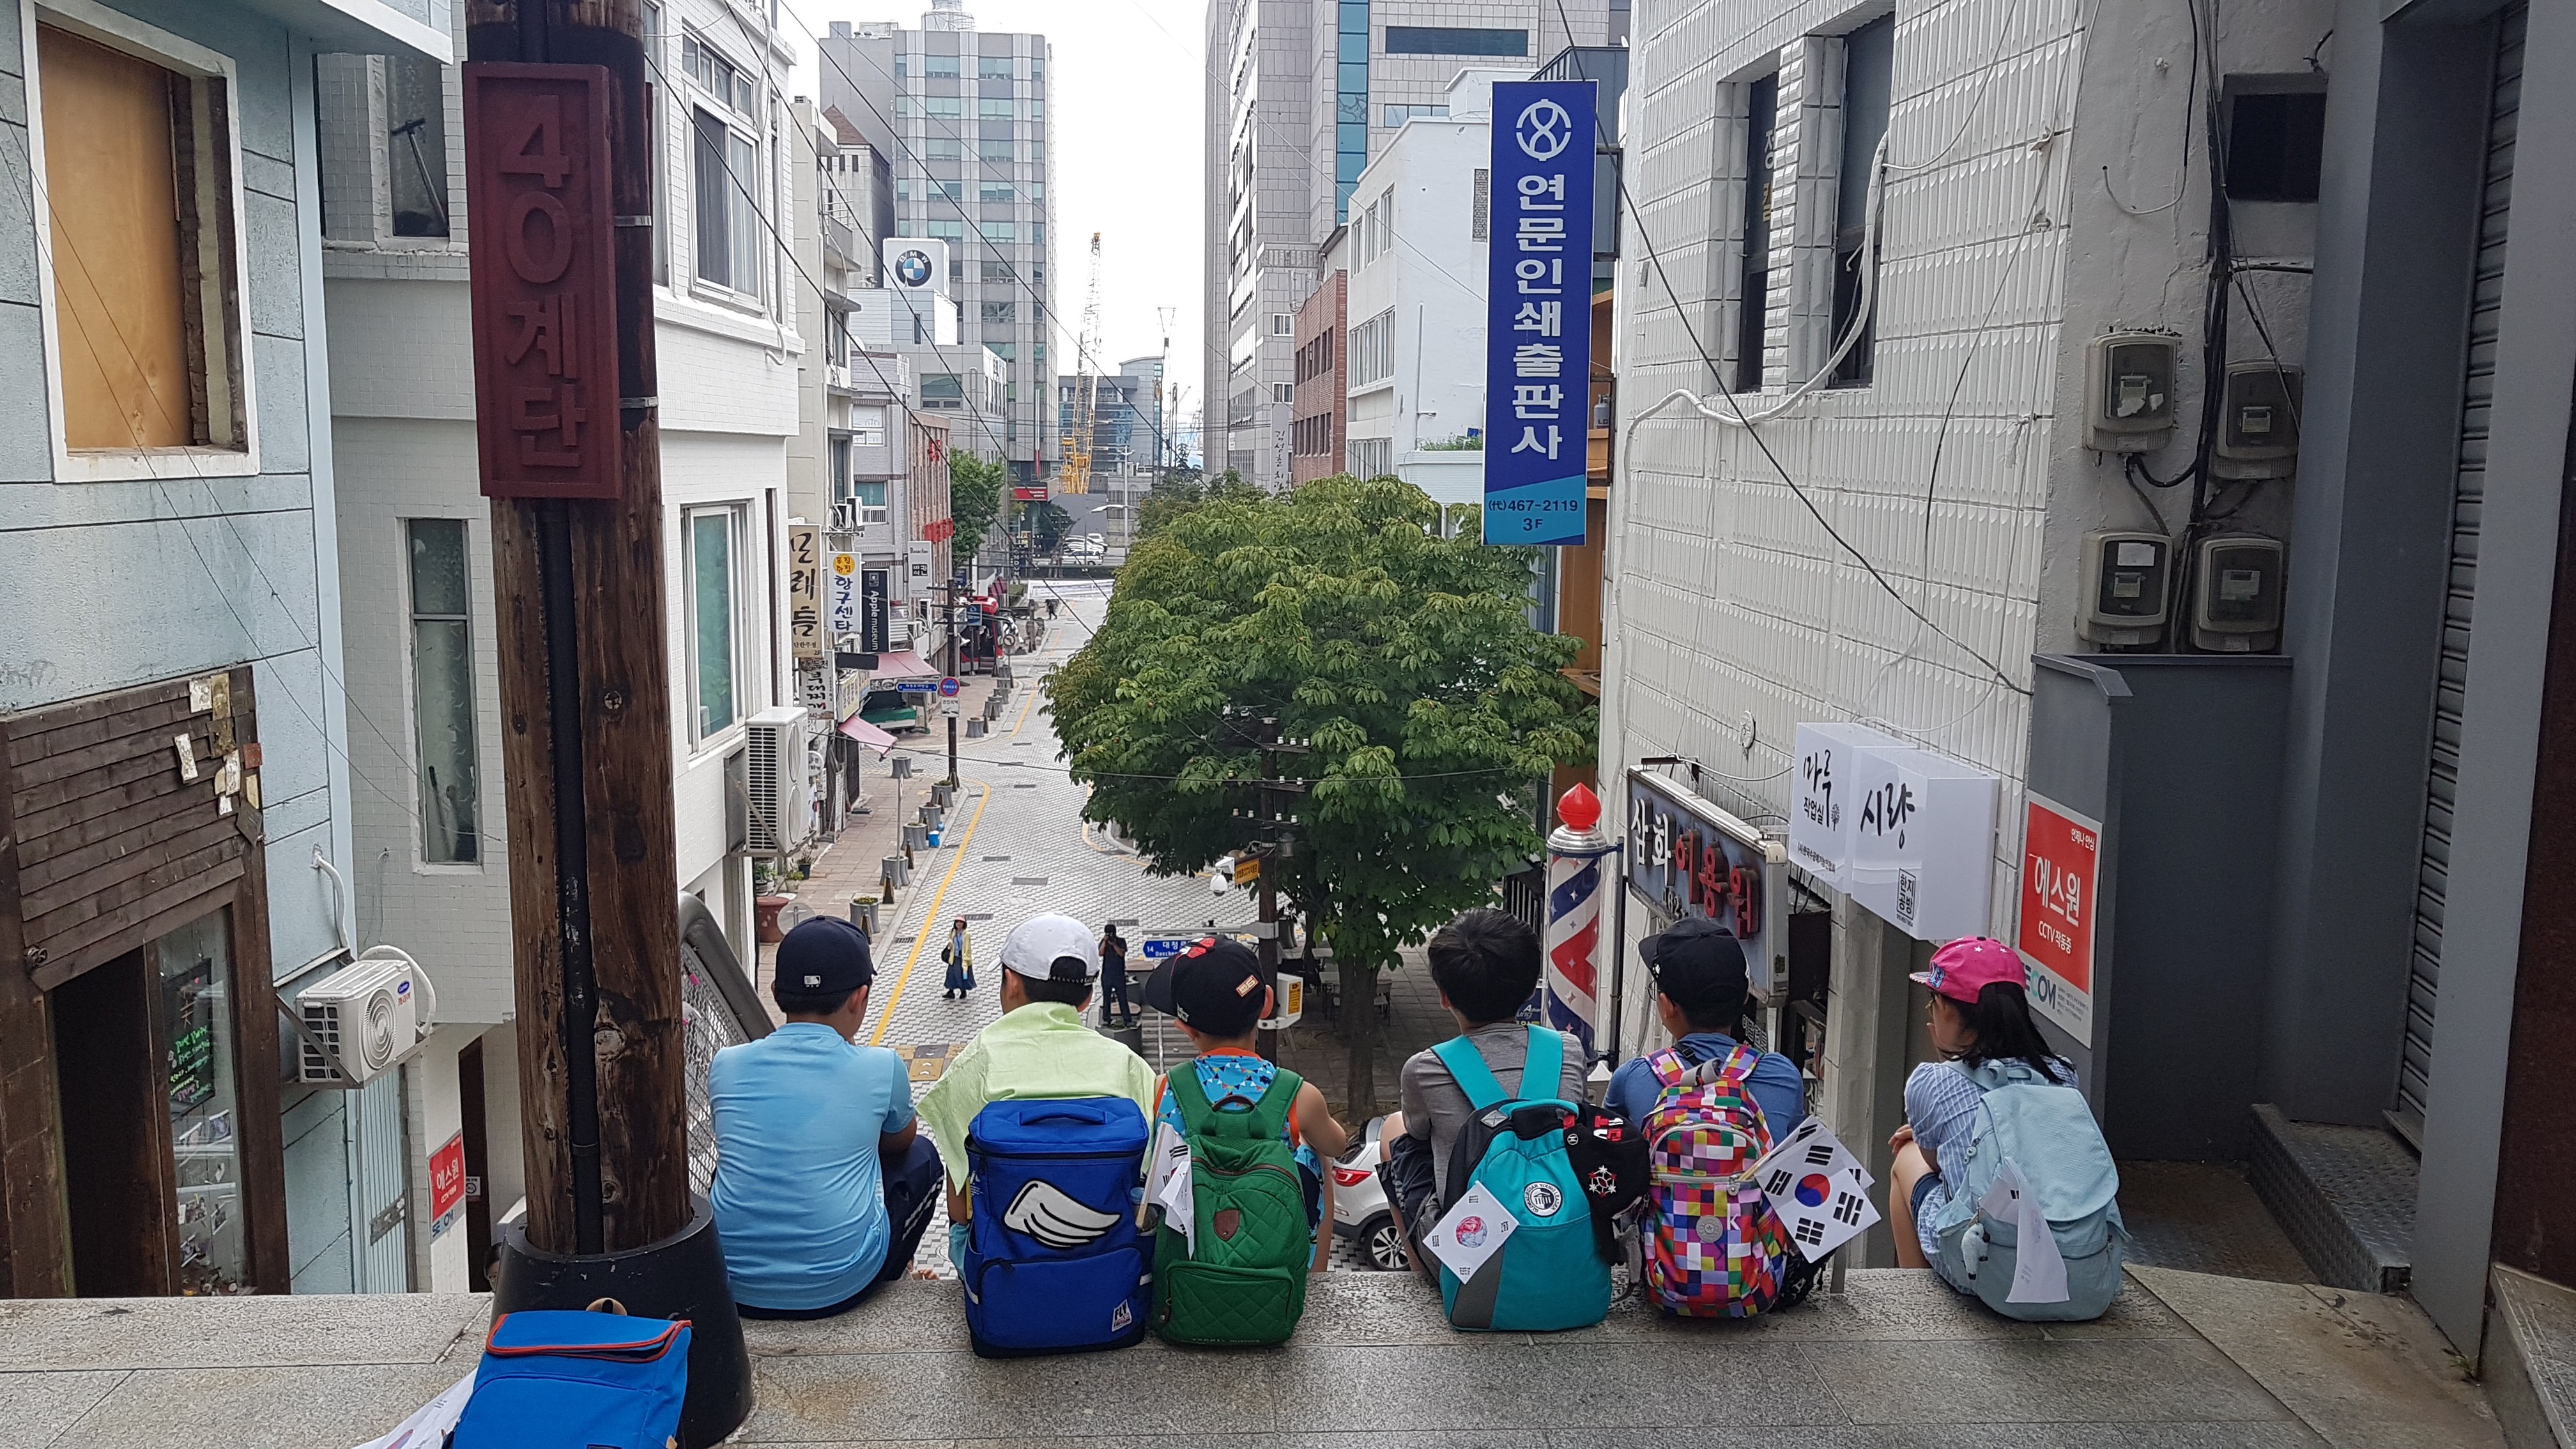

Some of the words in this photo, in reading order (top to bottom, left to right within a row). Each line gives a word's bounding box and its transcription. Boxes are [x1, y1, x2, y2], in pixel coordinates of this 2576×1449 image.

[898, 251, 929, 264] BMW
[499, 95, 586, 467] 40계단
[1511, 174, 1566, 460] 연문인쇄출판사
[834, 575, 854, 631] 항구센타
[1804, 797, 1824, 825] 작업실
[2071, 828, 2085, 847] 언제나
[2085, 834, 2095, 852] 안심
[2034, 856, 2081, 928] 에스원
[2039, 921, 2055, 943] CCTV
[2055, 930, 2072, 954] 작동중
[2021, 962, 2057, 1009] ECOM
[436, 1157, 459, 1190] 에스원
[432, 1209, 454, 1238] SEOM
[1114, 1301, 1127, 1321] FLY
